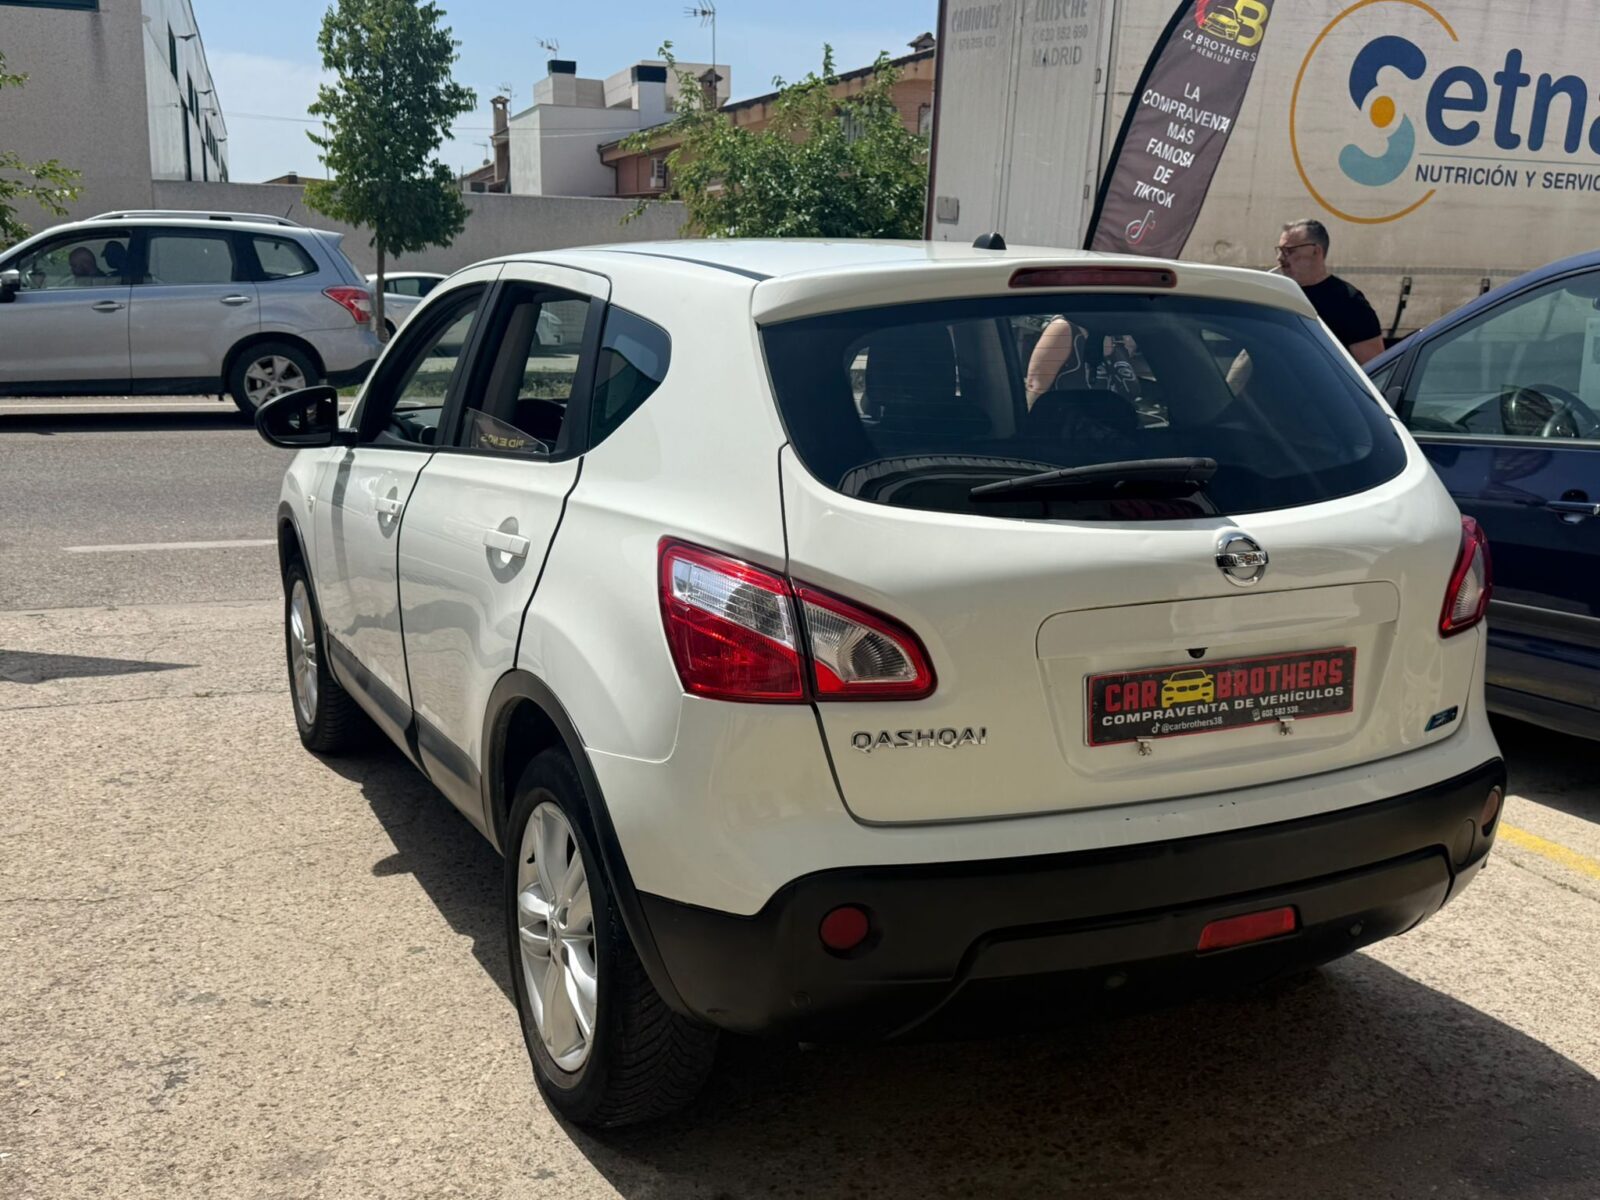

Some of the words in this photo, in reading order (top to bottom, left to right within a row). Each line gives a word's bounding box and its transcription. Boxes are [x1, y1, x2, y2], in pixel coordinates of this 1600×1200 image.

[1032, 46, 1082, 67] MADRID
[1190, 44, 1231, 64] PREMIUM
[1196, 34, 1257, 62] BROTHERS
[1184, 82, 1201, 102] LA
[1142, 89, 1231, 133] COMPRAVENTA
[1167, 122, 1195, 145] MÁS
[1146, 138, 1195, 168] FAMOSA
[1153, 165, 1174, 185] DE
[1415, 164, 1518, 187] NUTRICIÓN
[1525, 170, 1536, 188] Y
[1133, 181, 1175, 208] TIKTOK
[1105, 680, 1157, 712] CAR
[1217, 658, 1343, 699] BROTHERS
[1102, 702, 1229, 726] COMPRAVENTA
[1234, 698, 1254, 709] DE
[1259, 686, 1344, 706] VEHÍCULOS
[1161, 716, 1223, 734] @carbrothers38
[851, 727, 987, 753] QASHQAI
